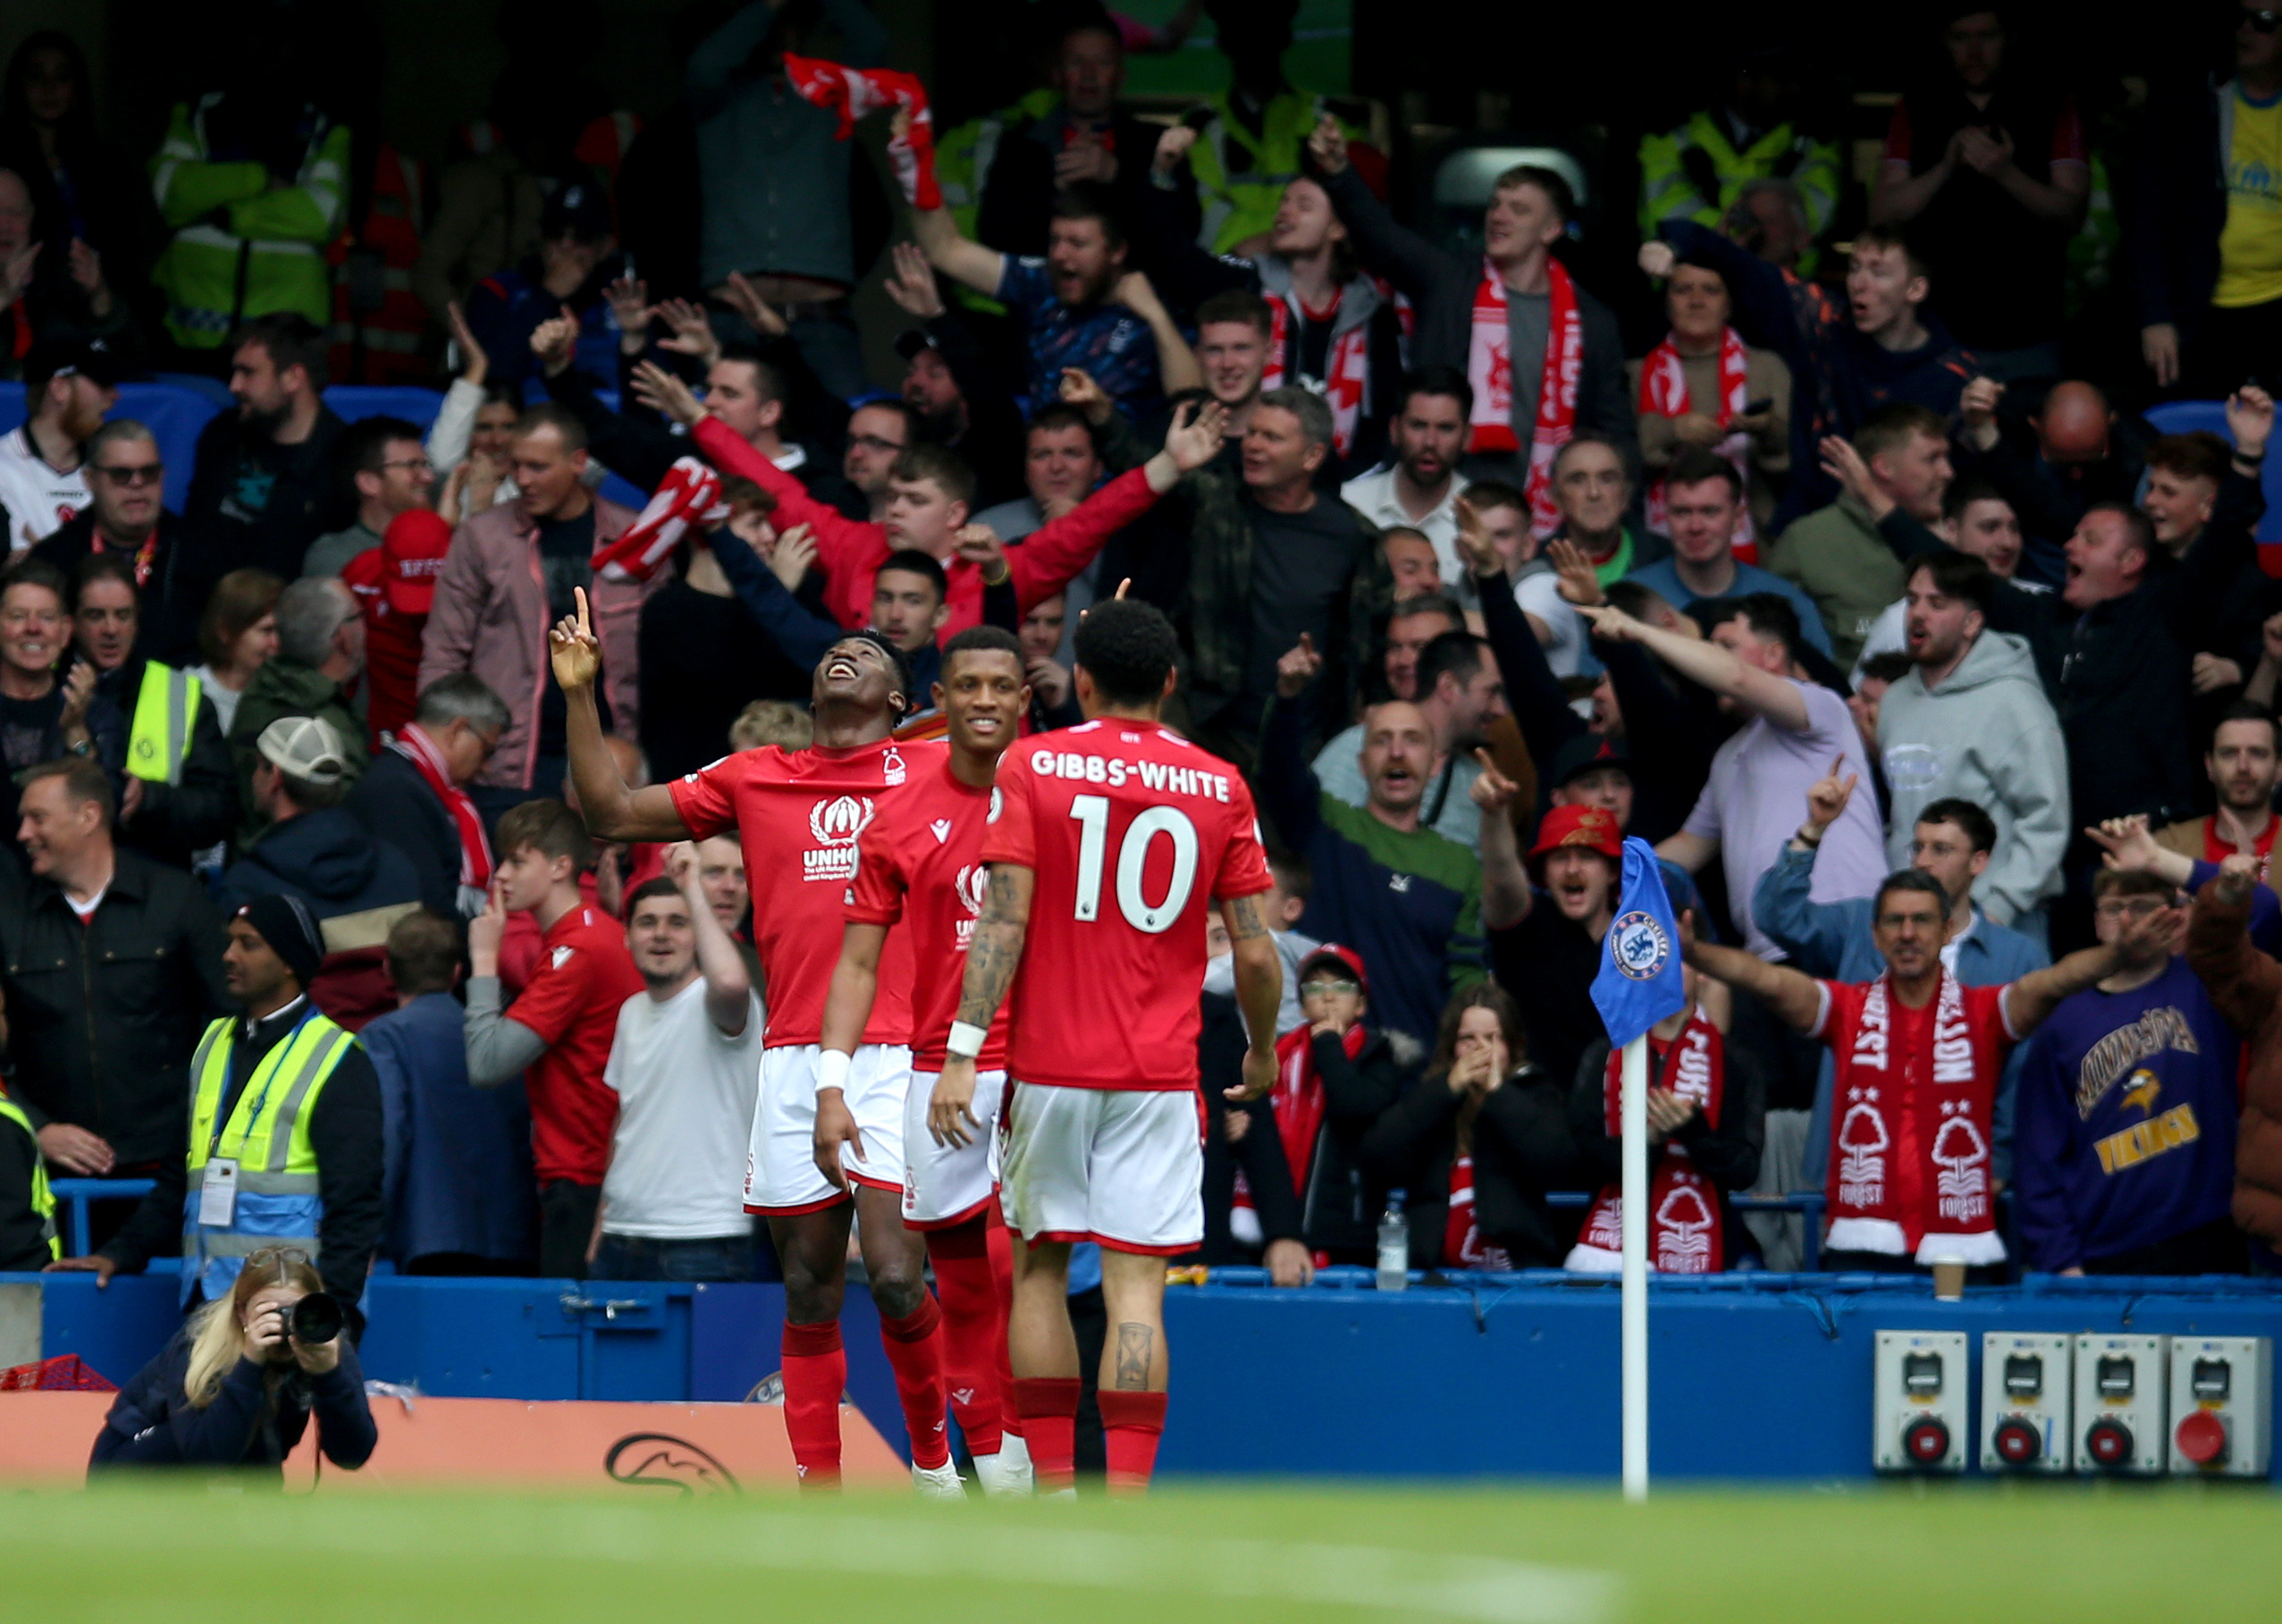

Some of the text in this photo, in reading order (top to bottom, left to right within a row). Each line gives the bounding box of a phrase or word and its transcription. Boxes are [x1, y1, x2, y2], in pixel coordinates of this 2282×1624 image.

[1031, 750, 1231, 803] GIBBS-WHITE
[1069, 794, 1200, 933] 10
[1839, 1183, 1885, 1208] FOREST
[1938, 1197, 1987, 1224] FOREST
